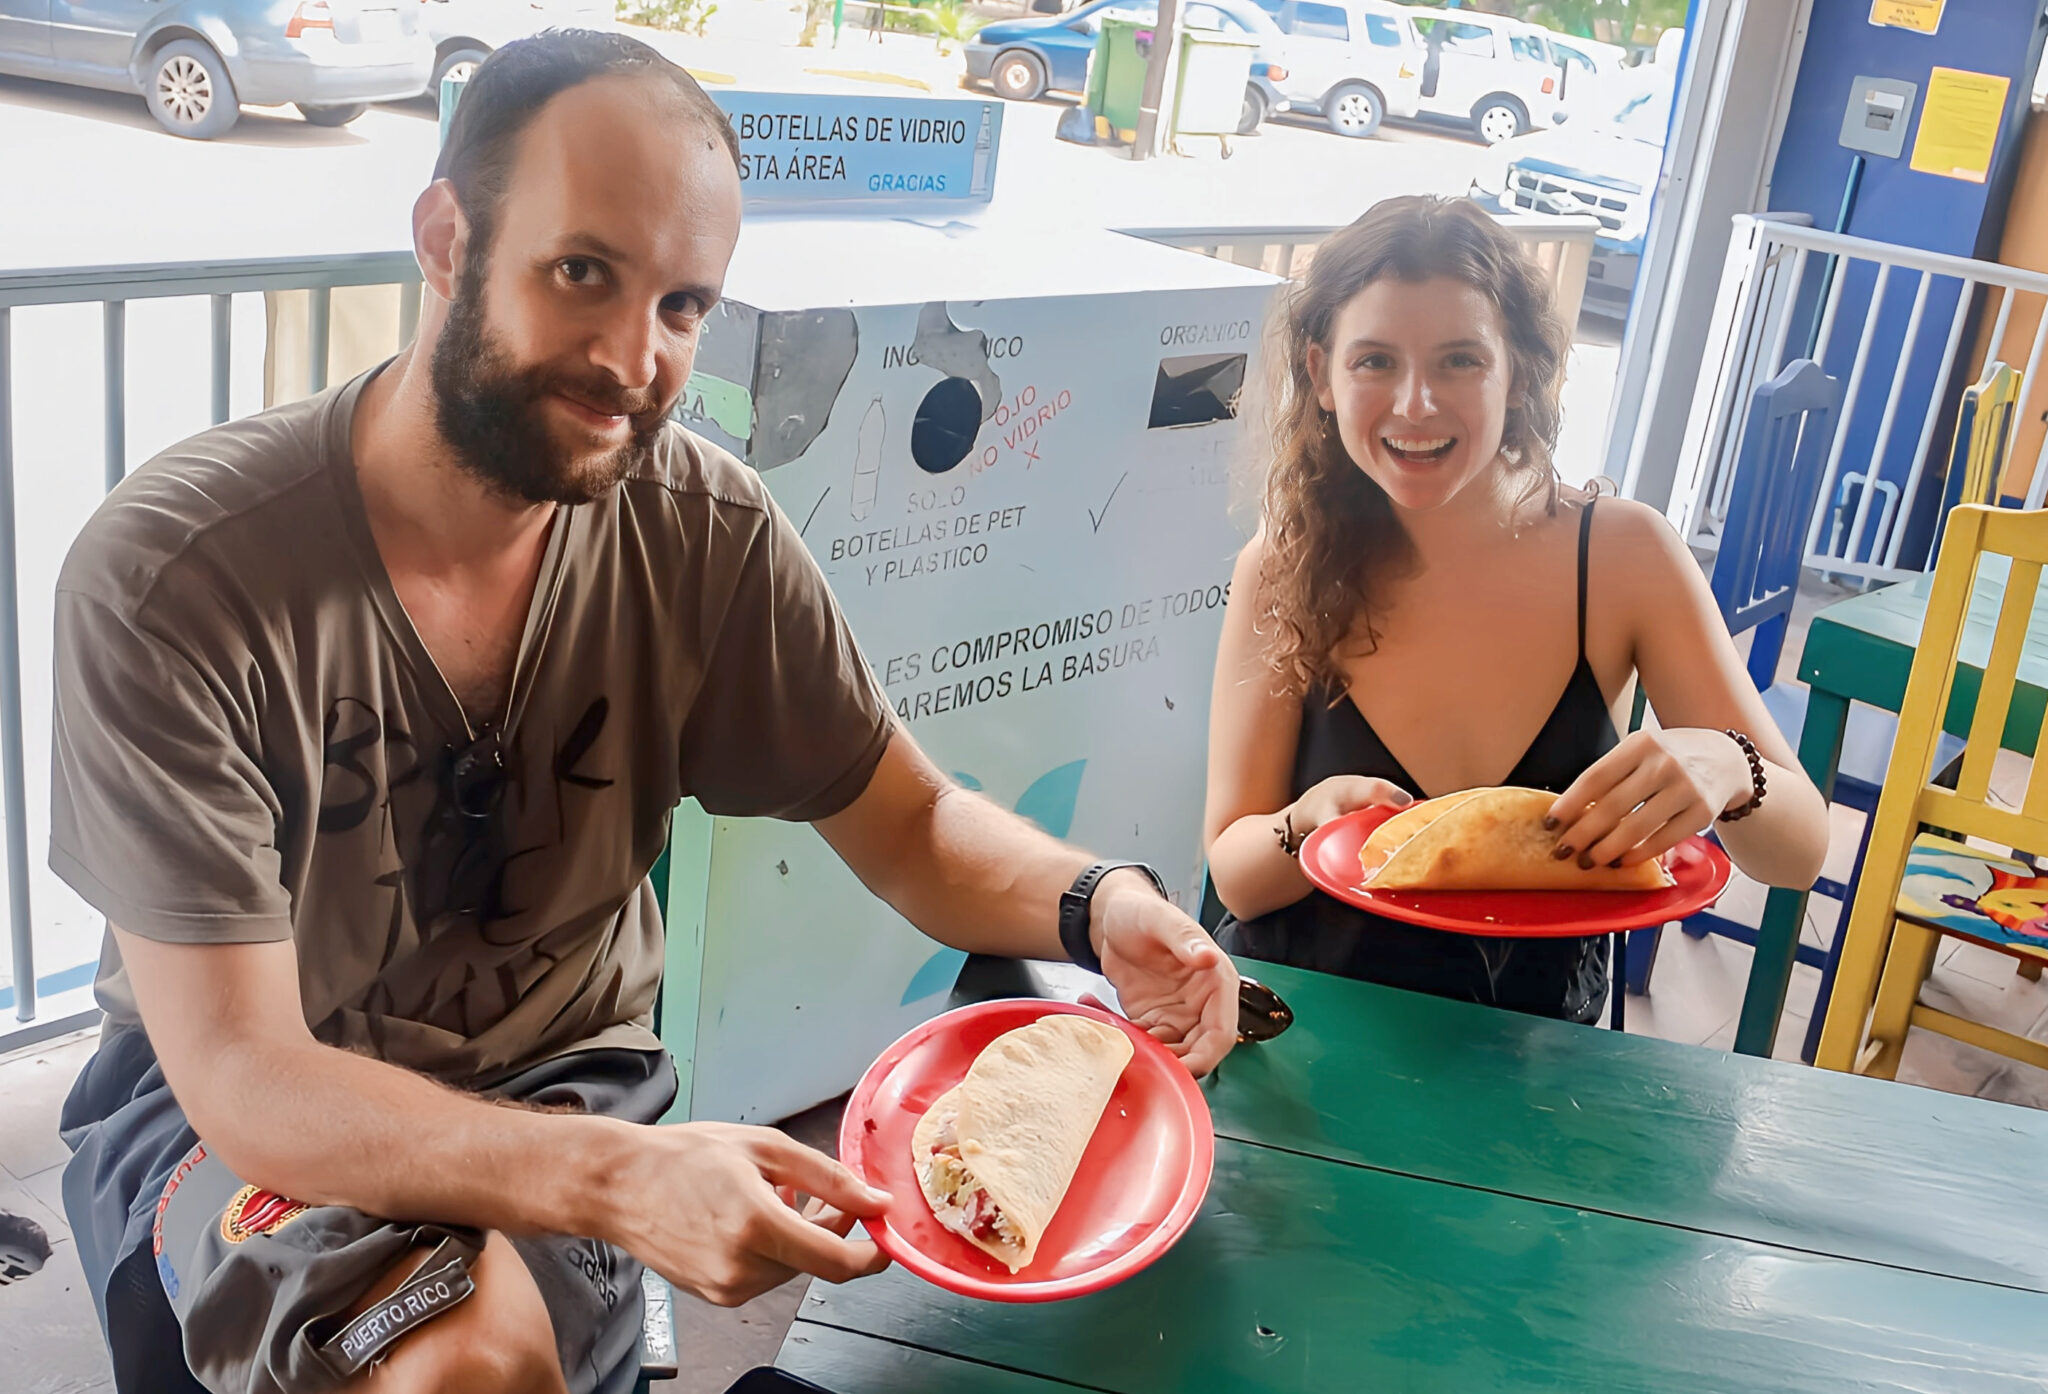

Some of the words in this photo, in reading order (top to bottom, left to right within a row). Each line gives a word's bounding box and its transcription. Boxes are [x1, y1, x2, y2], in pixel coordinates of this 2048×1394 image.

[740, 113, 858, 142] BOTELLAS
[866, 117, 893, 142] DE
[900, 118, 966, 145] VIDRIO
[739, 154, 780, 181] STA
[785, 146, 847, 181] ÁREA
[868, 173, 947, 193] GRACIAS
[994, 385, 1037, 427] OJO
[969, 446, 998, 477] NO
[1003, 389, 1072, 450] VIDRIO
[830, 519, 947, 561] BOTELLAS
[954, 513, 981, 537] DE
[987, 505, 1027, 534] PET
[865, 564, 879, 586] Y
[883, 543, 988, 583] PLASTICO
[885, 652, 921, 687] ES
[931, 609, 1113, 674] COMPROMISO
[1120, 600, 1153, 630] DE
[896, 671, 1013, 722] AREMOS
[1022, 661, 1053, 692] LA
[1062, 636, 1160, 682] BASURA
[340, 1304, 406, 1361] PUERTO
[404, 1281, 450, 1317] RICO
